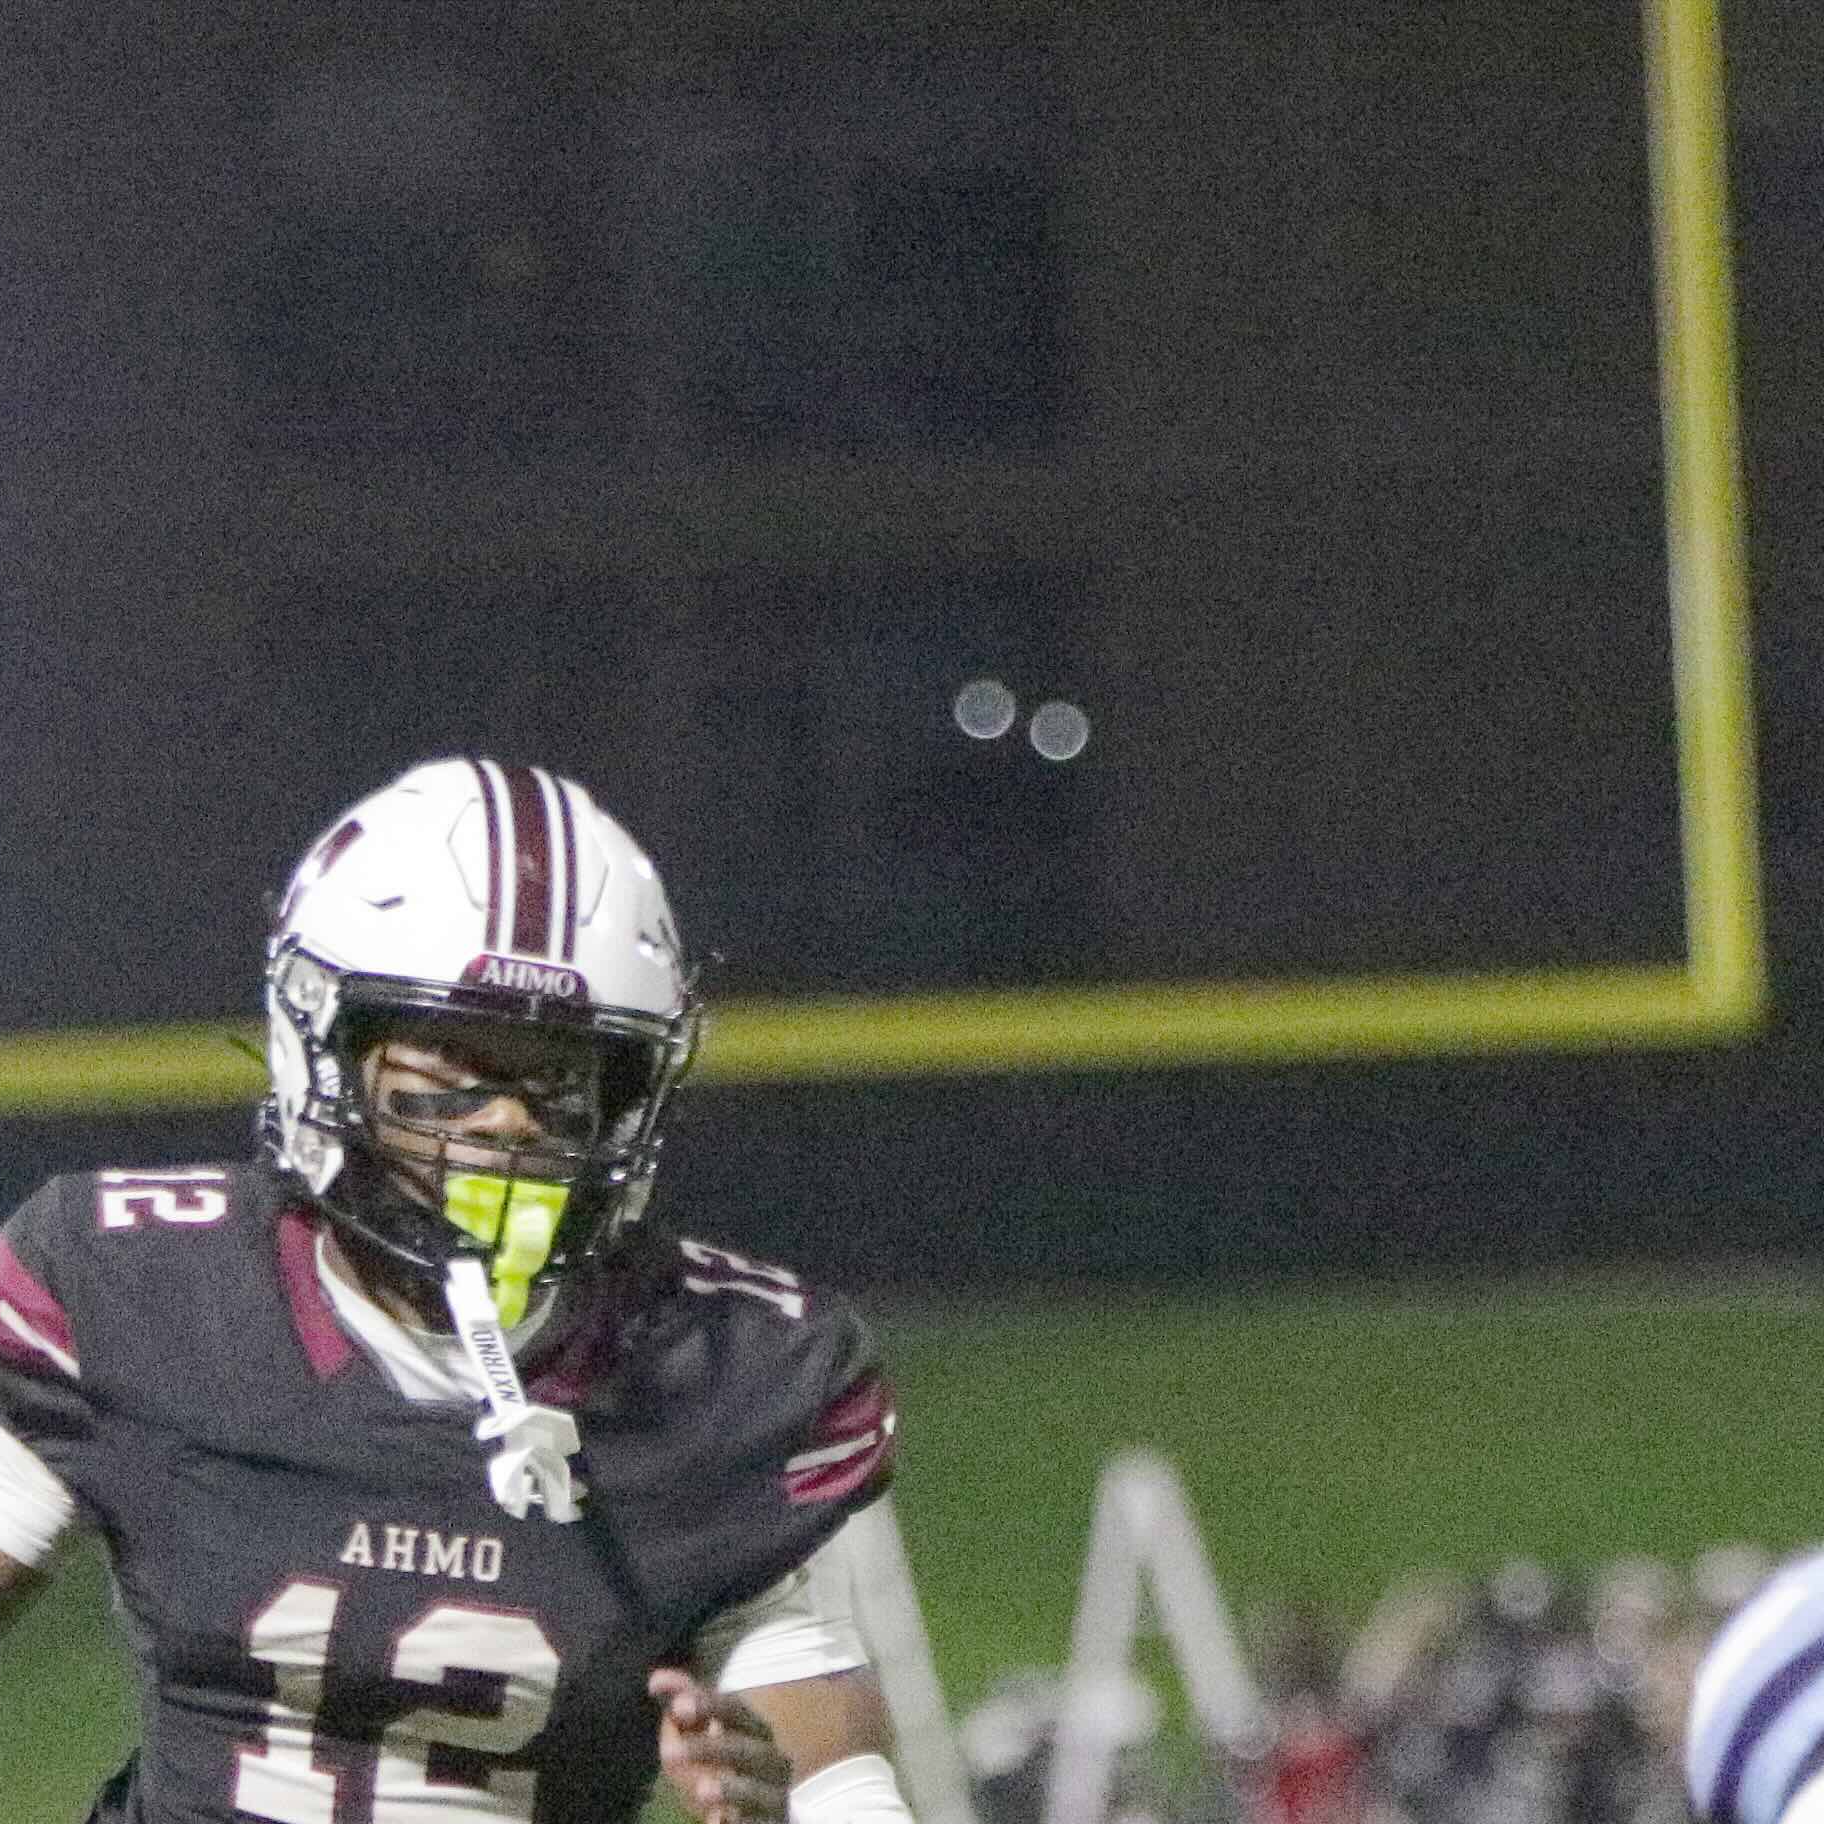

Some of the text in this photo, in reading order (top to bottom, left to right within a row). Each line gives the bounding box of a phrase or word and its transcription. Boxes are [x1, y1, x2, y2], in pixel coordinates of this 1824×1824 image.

[480, 956, 578, 998] AHMO
[471, 1328, 519, 1404] NXTRND
[341, 1522, 505, 1583] AHMO
